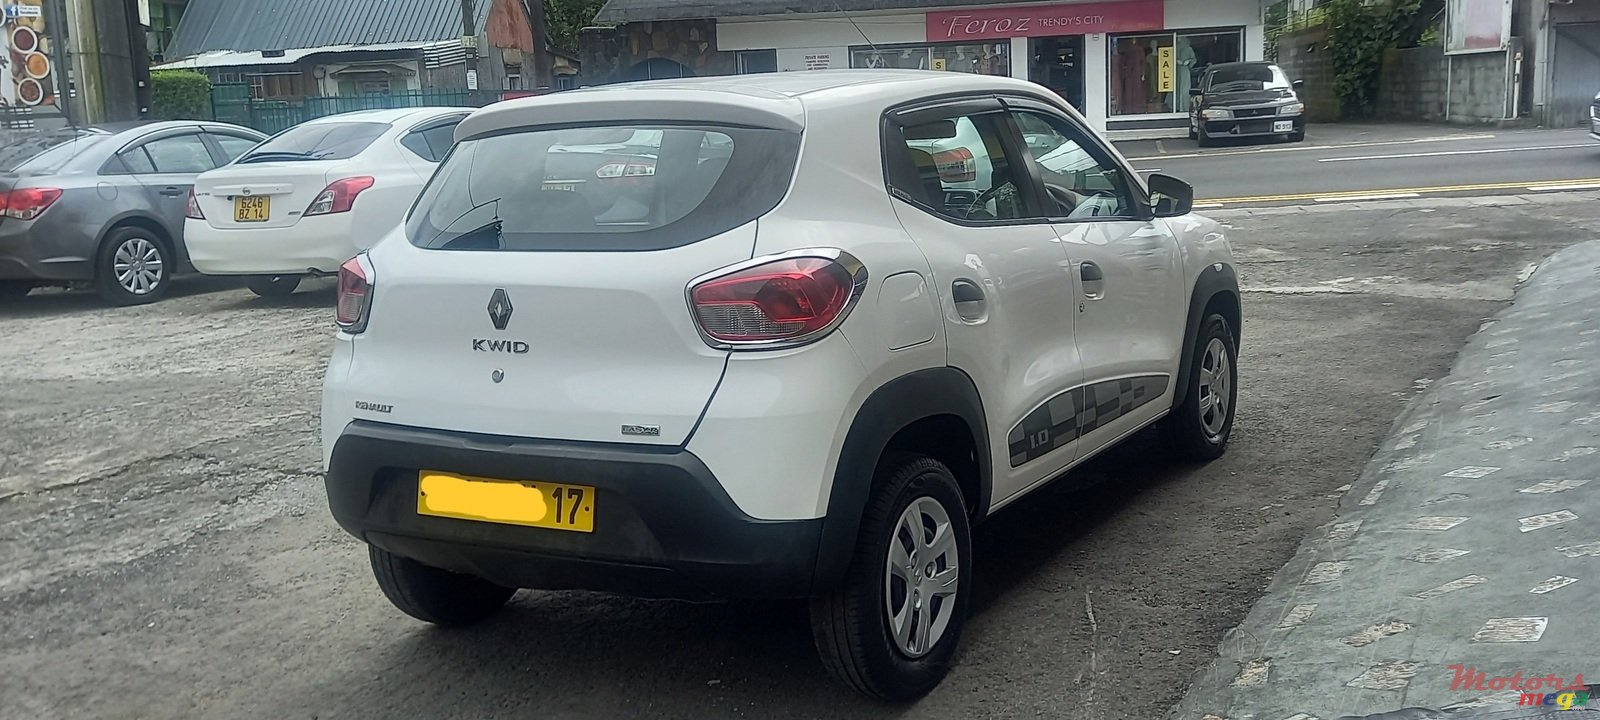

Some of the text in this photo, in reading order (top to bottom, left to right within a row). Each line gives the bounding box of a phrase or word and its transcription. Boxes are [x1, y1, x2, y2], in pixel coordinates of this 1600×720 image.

[1038, 15, 1104, 27] TRENDY'S CITY
[241, 198, 263, 209] 6246
[239, 208, 264, 219] BZ 14
[472, 338, 530, 354] KWID
[1029, 428, 1049, 449] 1.0
[551, 487, 584, 525] 17
